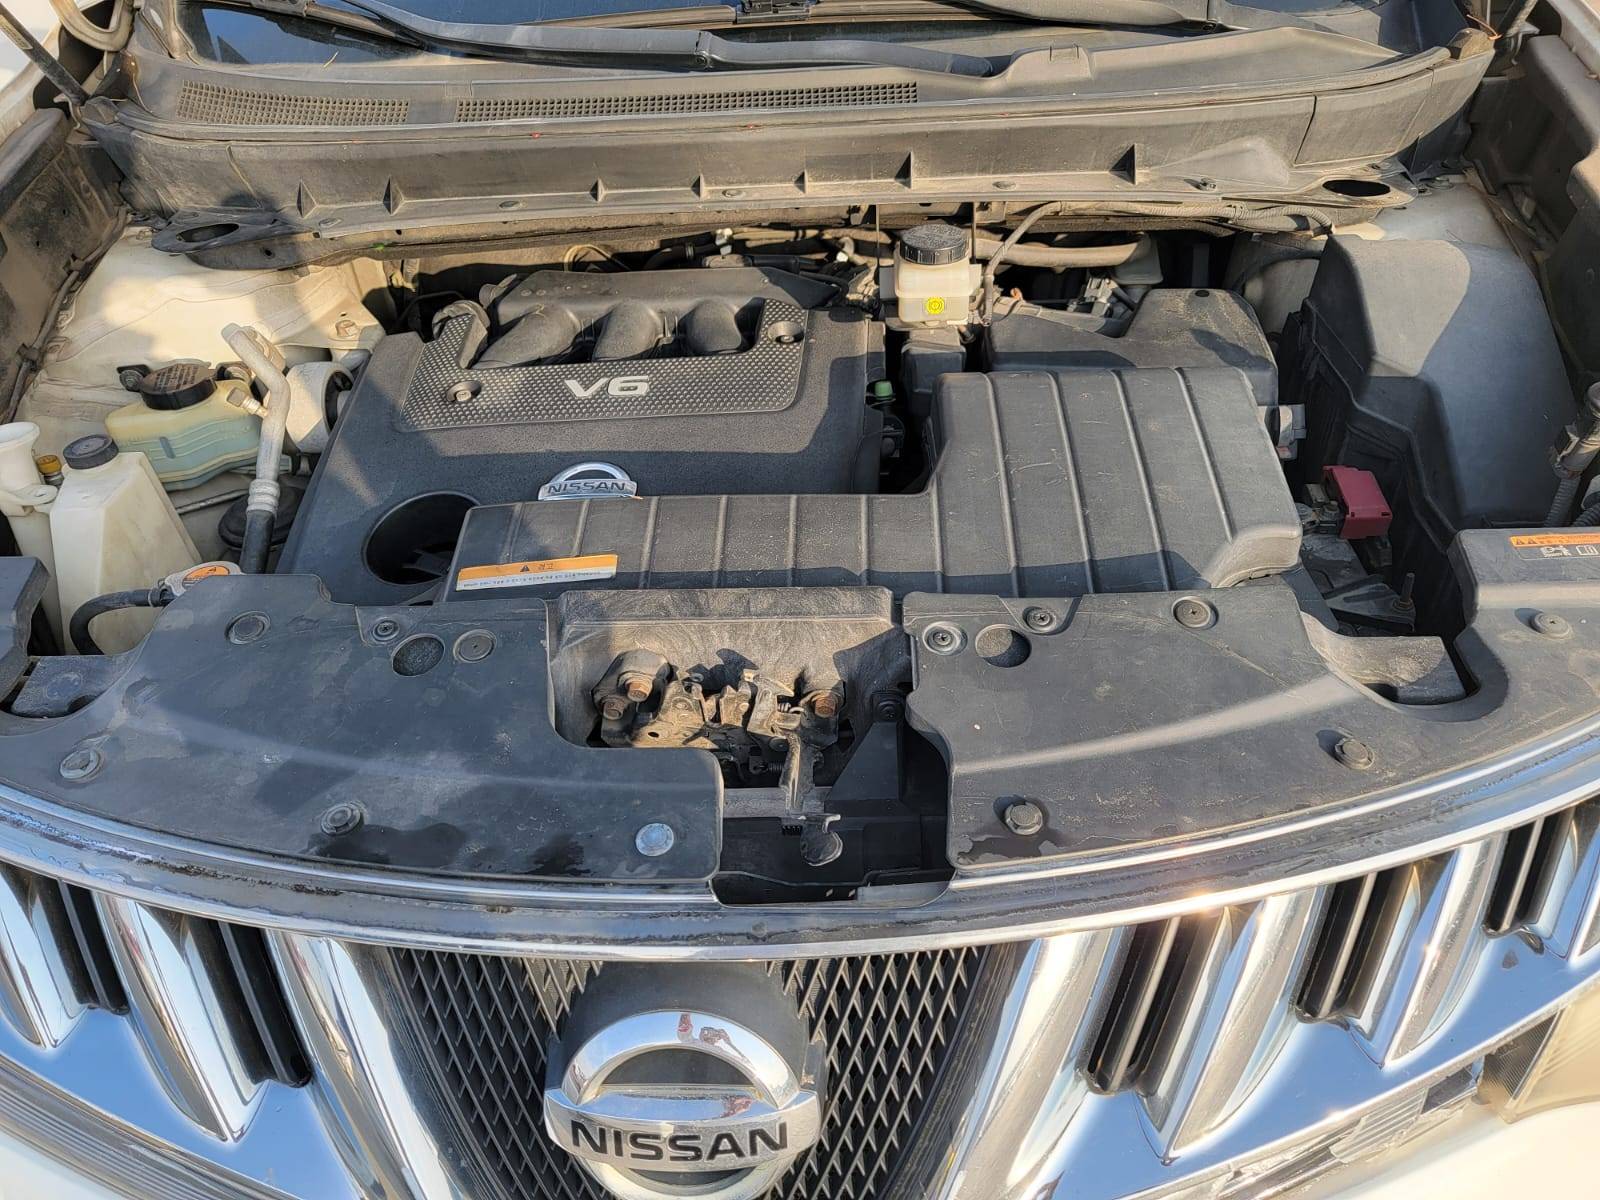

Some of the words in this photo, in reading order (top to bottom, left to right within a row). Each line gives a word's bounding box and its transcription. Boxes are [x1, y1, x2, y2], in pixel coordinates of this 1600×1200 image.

[564, 375, 649, 397] V6
[548, 481, 626, 494] NISSAN
[571, 1120, 788, 1163] NISSAN
